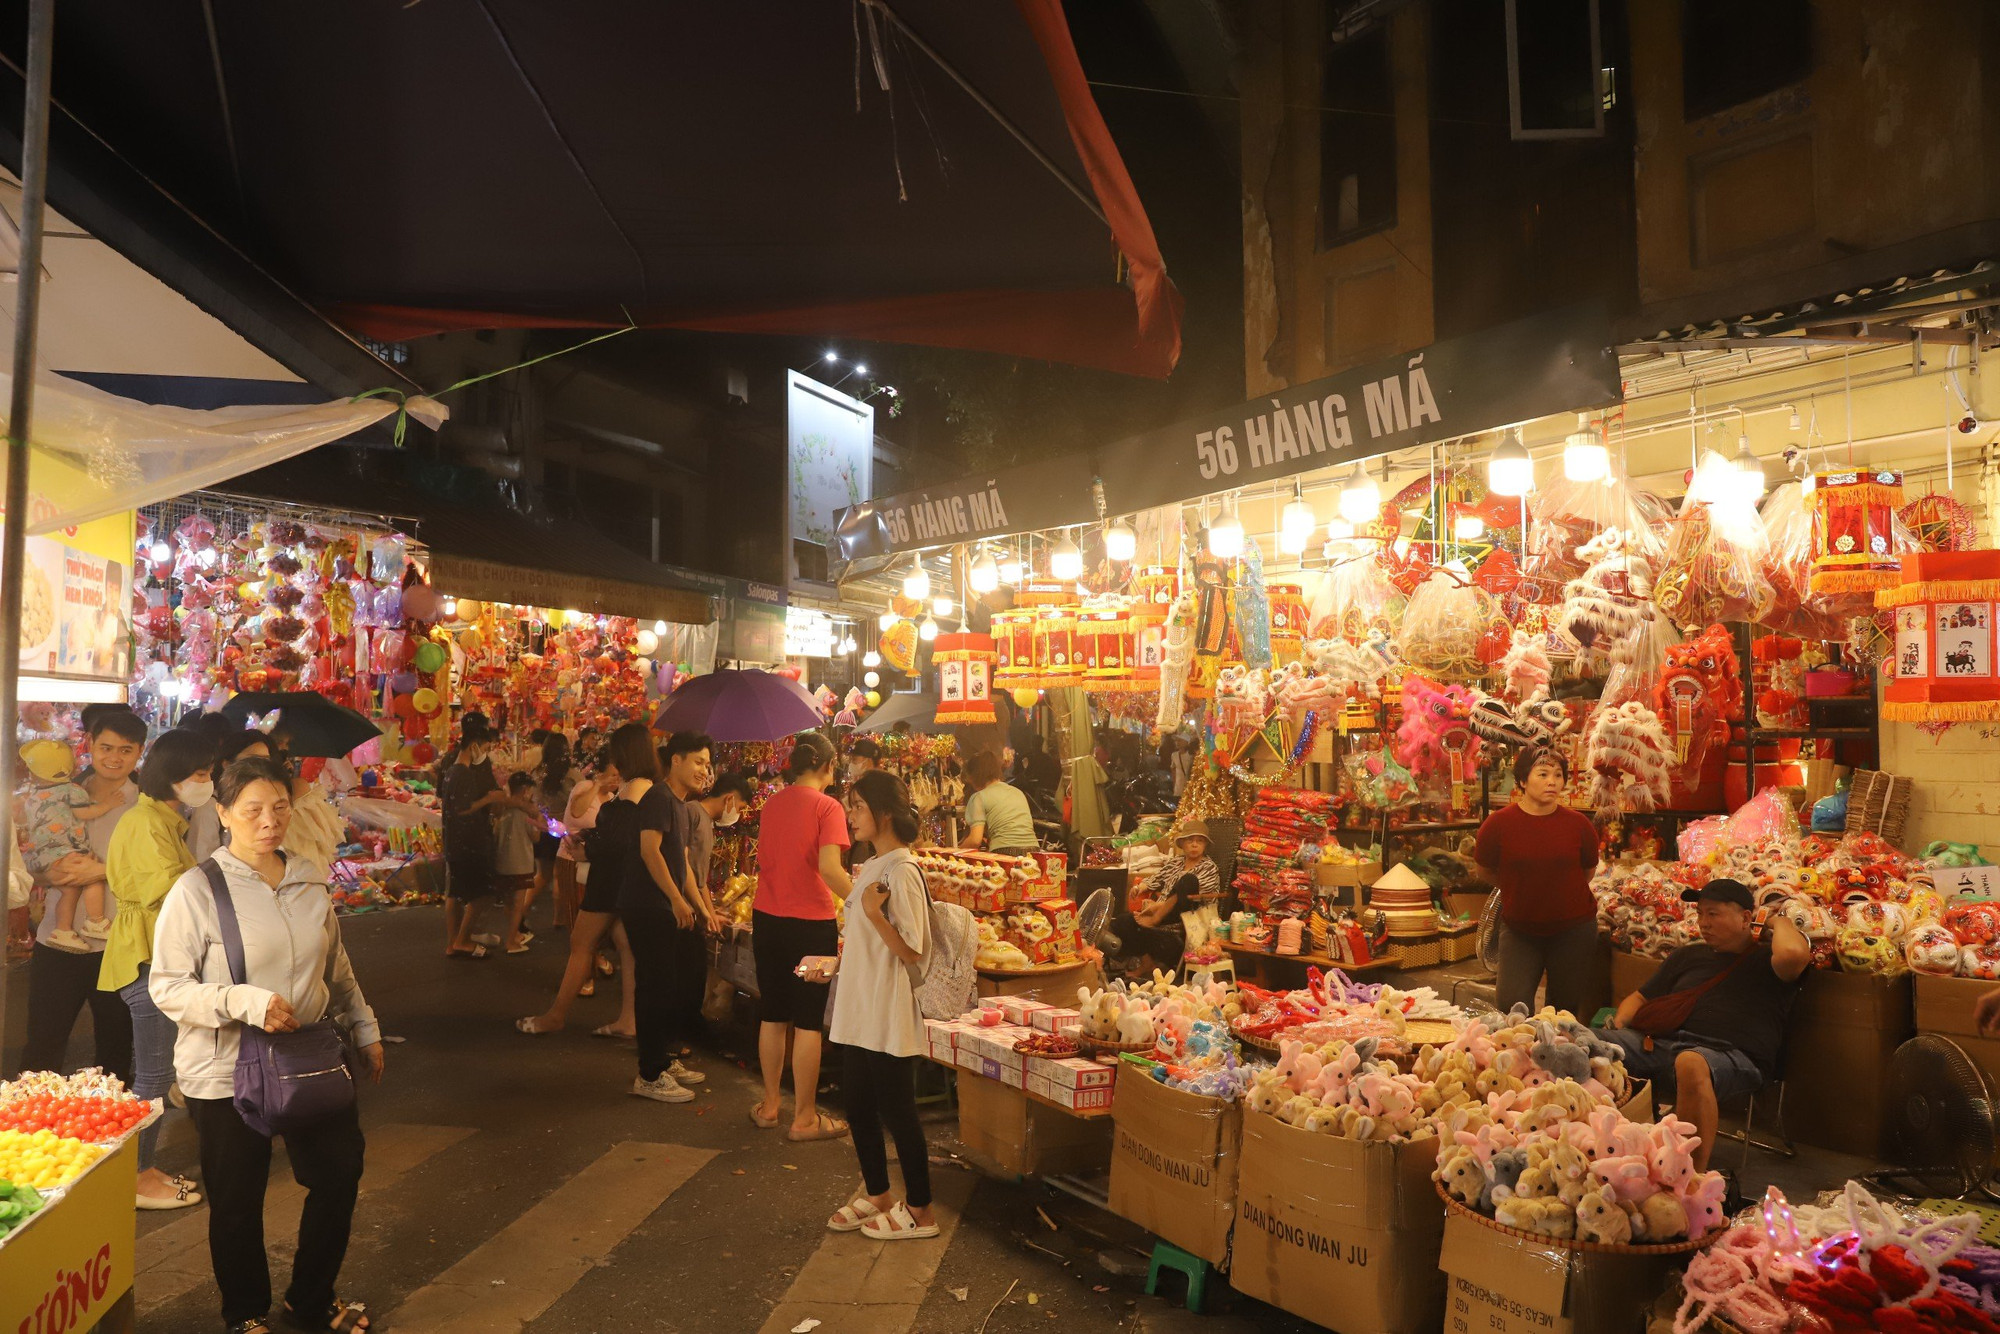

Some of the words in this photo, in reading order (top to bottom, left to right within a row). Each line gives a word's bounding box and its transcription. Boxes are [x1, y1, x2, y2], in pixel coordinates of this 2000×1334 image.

[1196, 425, 1239, 480] 56
[1245, 393, 1354, 468] HÀNG
[1362, 352, 1442, 438] MÃ
[884, 508, 910, 544] 56
[910, 494, 969, 540] HÀNG
[968, 479, 1009, 532] MÃ
[747, 583, 779, 603] Salonpas
[1138, 1143, 1162, 1173] DONG
[1163, 1157, 1190, 1184] WAN
[1192, 1167, 1210, 1187] JU
[1243, 1200, 1266, 1230] DIAN
[1268, 1215, 1304, 1247] DONG
[1307, 1231, 1341, 1260] WAN
[1347, 1245, 1367, 1267] JU
[1453, 1316, 1468, 1334] KGS
[1455, 1297, 1469, 1315] KGS
